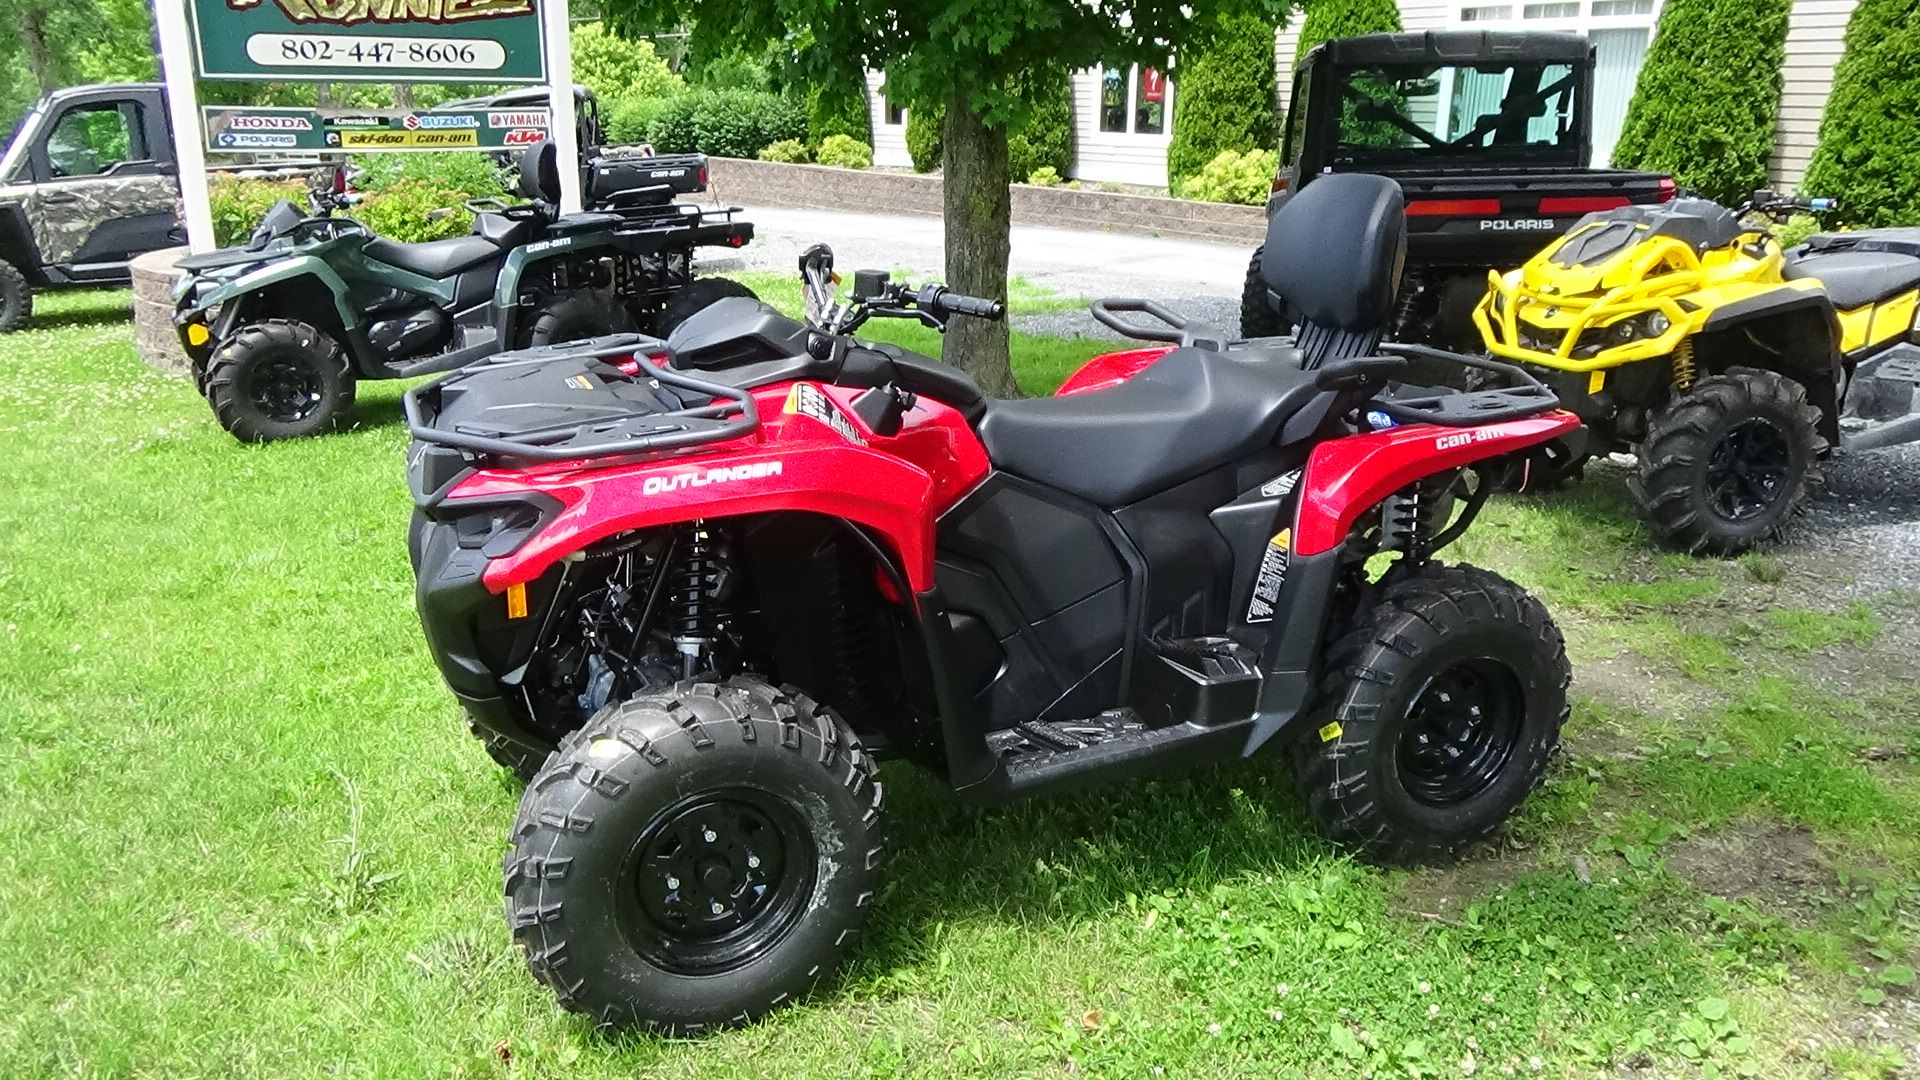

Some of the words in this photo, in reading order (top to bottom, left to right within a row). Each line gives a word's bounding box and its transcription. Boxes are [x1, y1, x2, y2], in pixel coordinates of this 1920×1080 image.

[281, 39, 475, 63] 802-447-8606
[233, 118, 309, 128] HONDA
[334, 117, 379, 125] Kawasaki
[421, 117, 474, 127] SUZUKI
[503, 114, 547, 126] YAMAHA
[348, 133, 404, 144] ski-doo
[416, 133, 471, 144] can-am
[506, 131, 545, 143] KTM
[1480, 219, 1554, 230] POLARIS
[1435, 429, 1504, 450] can-am
[642, 461, 783, 496] OUTLANDER
